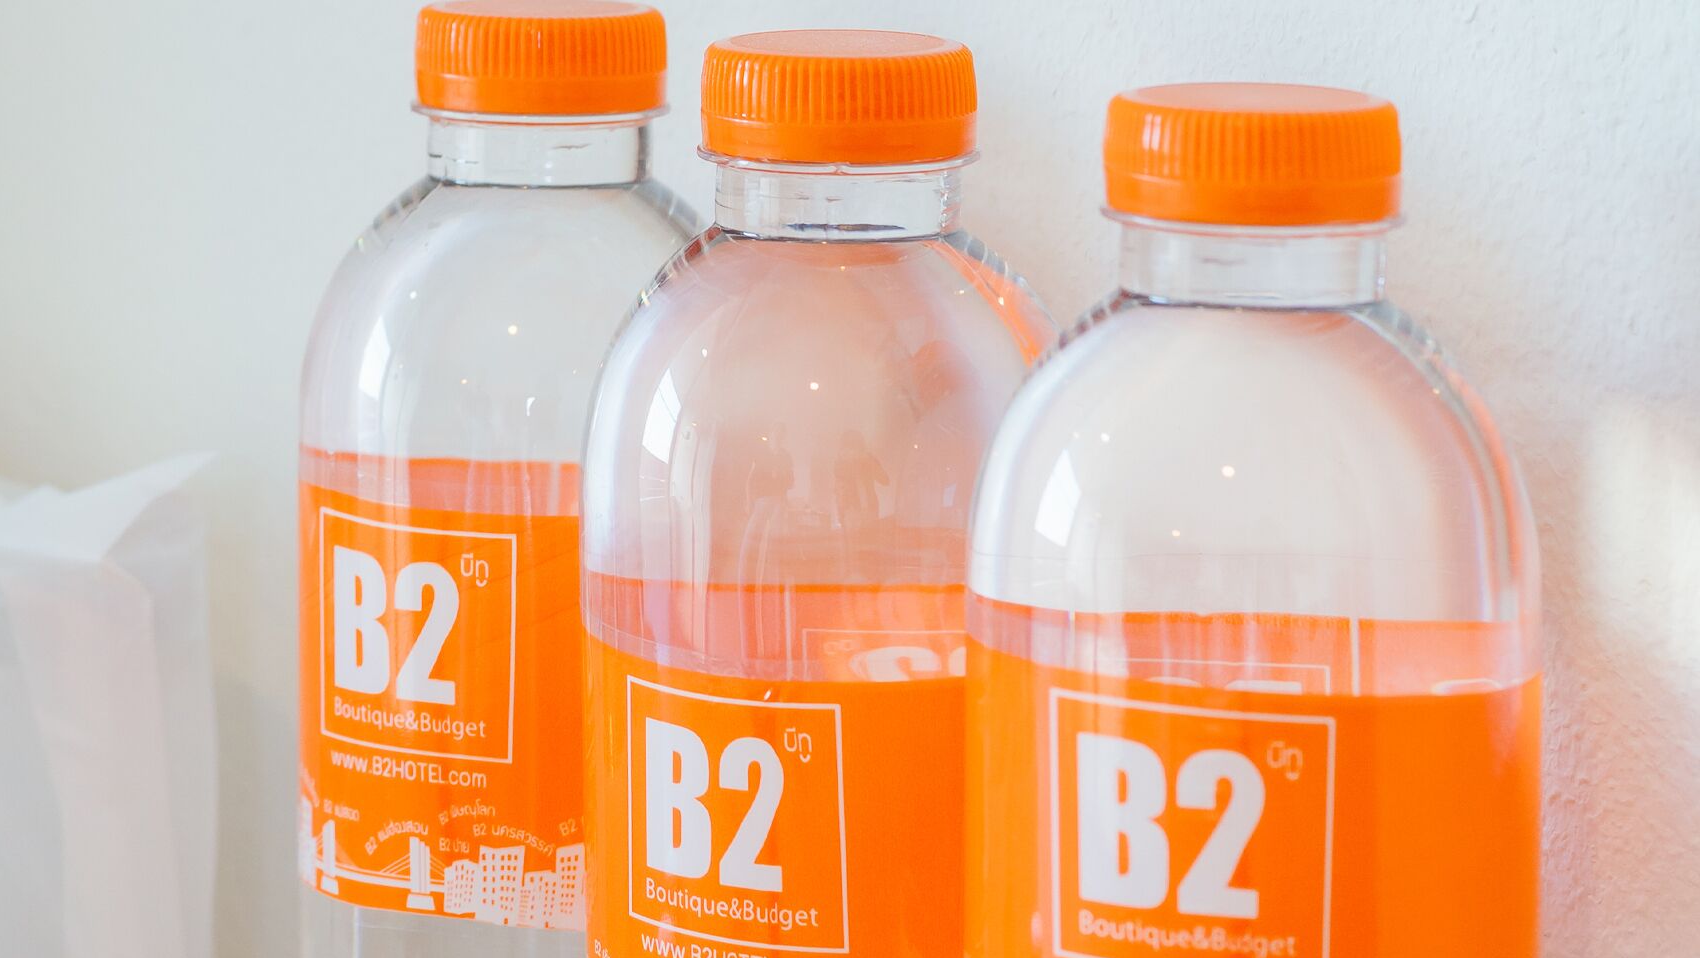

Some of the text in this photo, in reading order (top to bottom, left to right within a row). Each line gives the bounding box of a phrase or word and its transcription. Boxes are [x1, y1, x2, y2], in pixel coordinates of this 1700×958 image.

[333, 545, 459, 705] B2
[334, 696, 486, 740] Boutique&Budget
[331, 750, 487, 788] www.B2HOTEL.com
[646, 717, 785, 892] B2
[1076, 731, 1265, 920] B2
[646, 877, 819, 931] Boutique&Budget
[1078, 909, 1296, 958] Boutique&Budget
